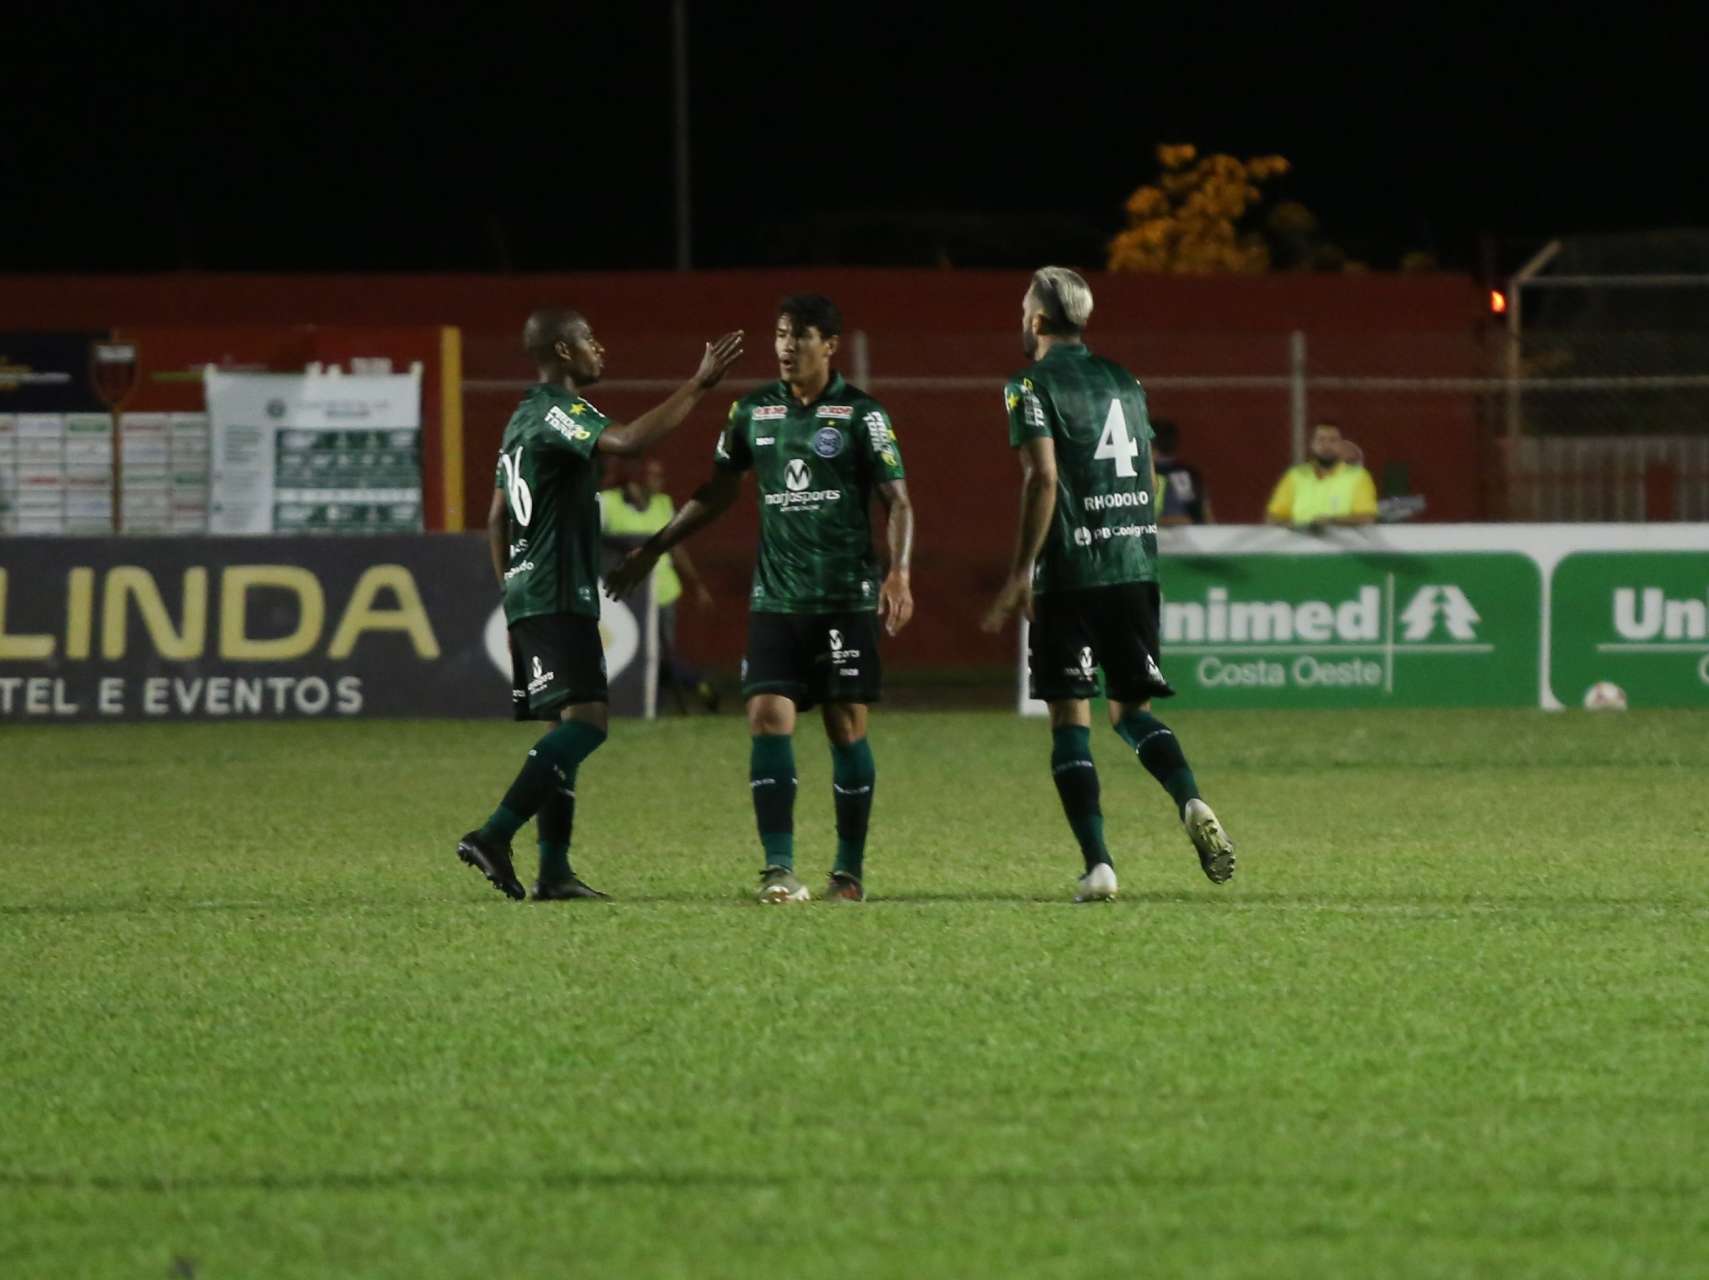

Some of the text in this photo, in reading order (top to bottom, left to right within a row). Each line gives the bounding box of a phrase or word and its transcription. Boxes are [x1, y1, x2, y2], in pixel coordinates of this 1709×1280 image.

[1094, 398, 1138, 477] 4
[1083, 491, 1149, 511] RHODOLO
[0, 565, 440, 661] LINDA
[1161, 584, 1380, 641] nimed
[1614, 587, 1709, 639] Un
[0, 677, 363, 714] TEL E EVENTOS
[1198, 655, 1383, 687] Costa Oeste
